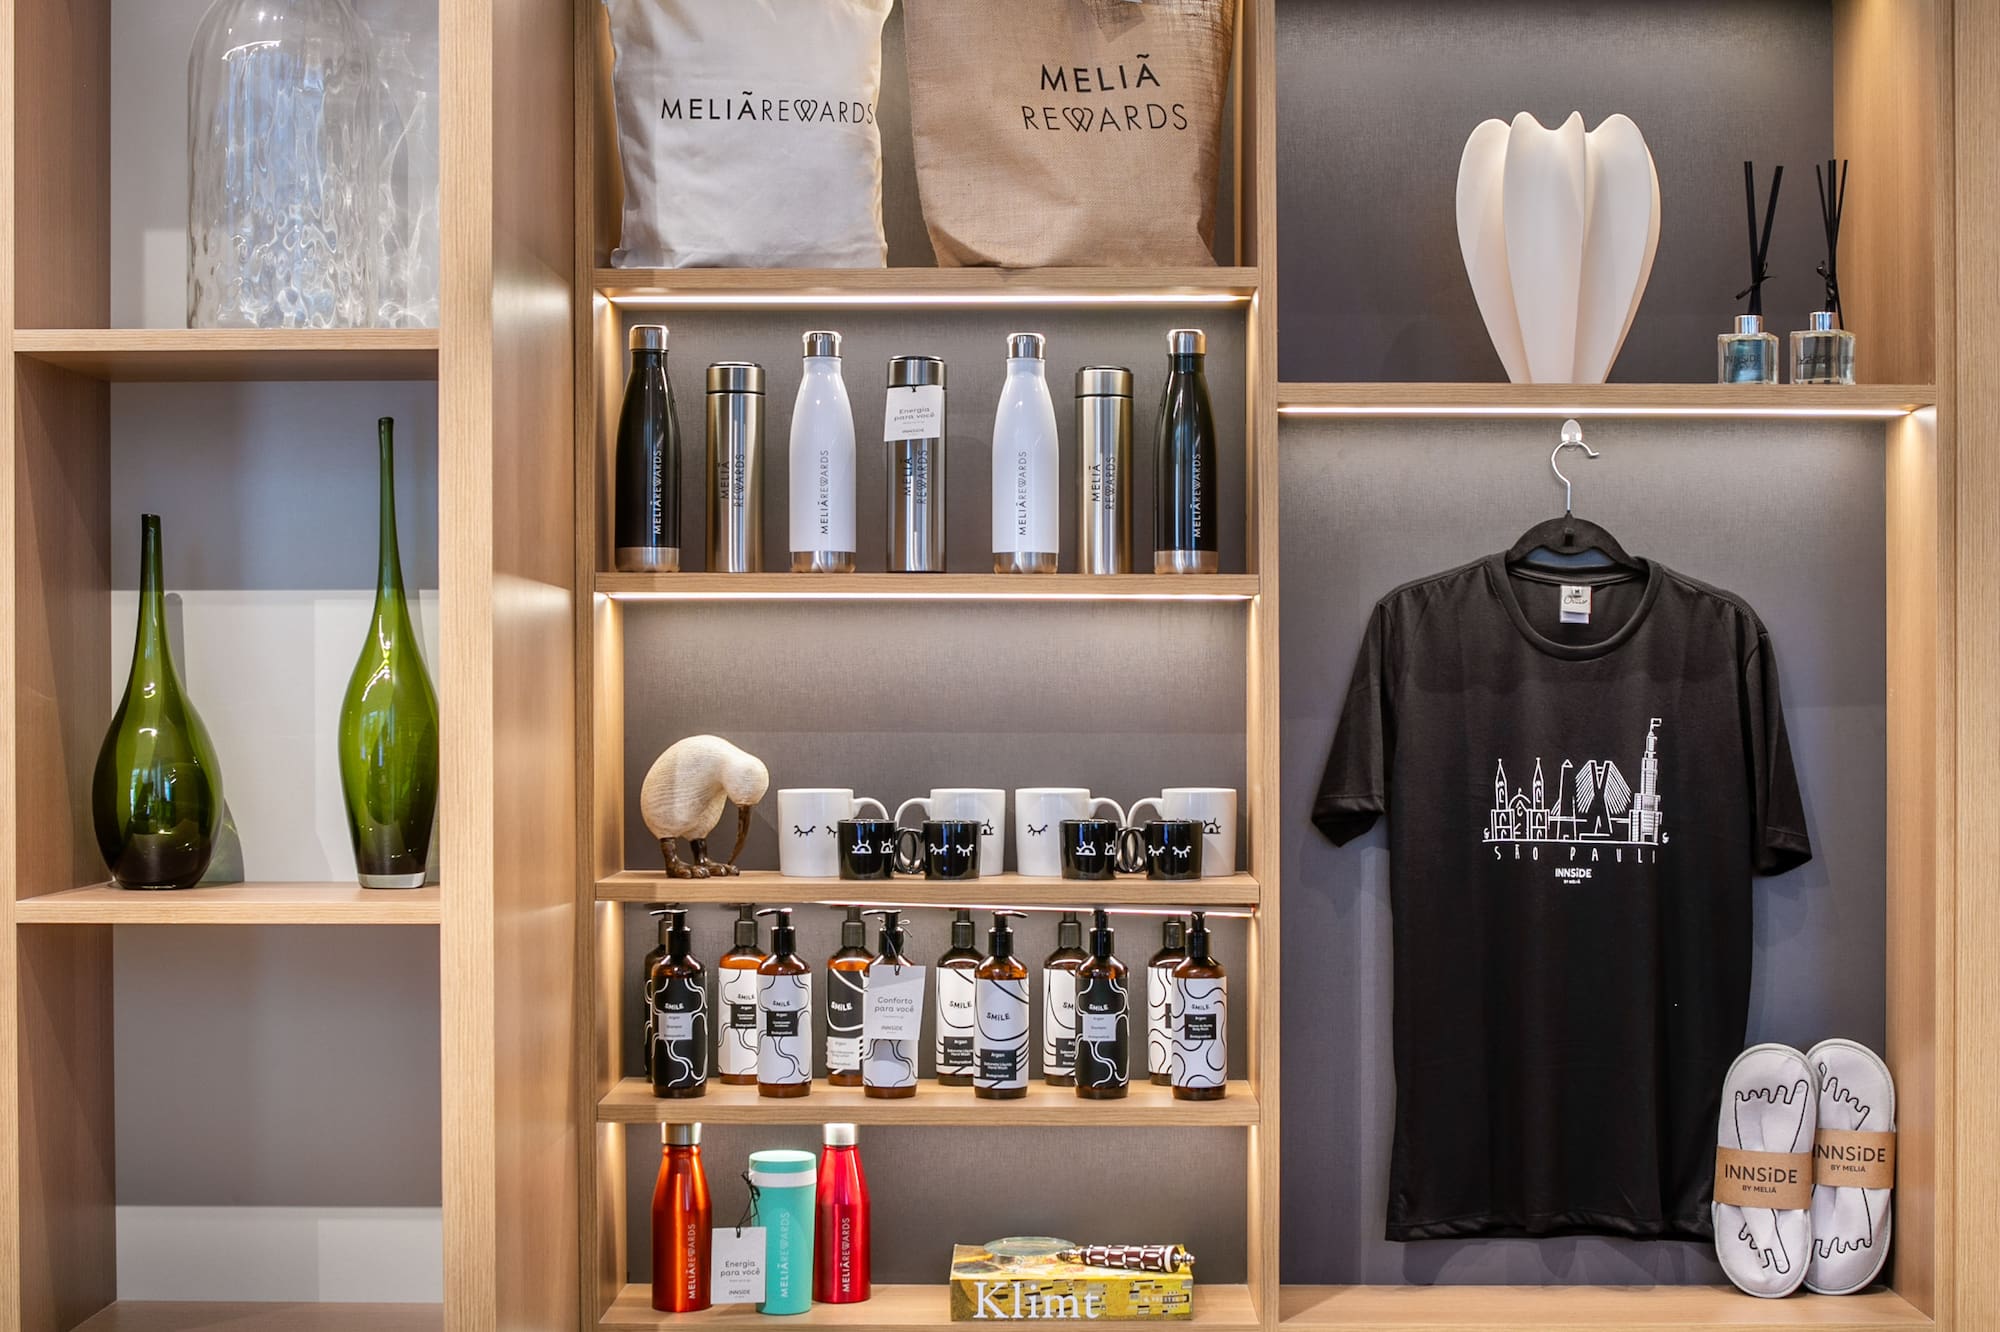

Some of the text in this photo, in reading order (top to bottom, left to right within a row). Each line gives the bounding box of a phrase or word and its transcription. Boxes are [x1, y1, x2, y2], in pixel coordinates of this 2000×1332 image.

[1021, 103, 1187, 132] REWARDS
[1494, 844, 1538, 861] SÃO
[877, 996, 913, 1004] Conforto
[1725, 1164, 1797, 1184] INNSiDE
[720, 1267, 760, 1278] para você
[725, 1260, 756, 1269] Energia
[973, 1280, 1100, 1319] Klimt
